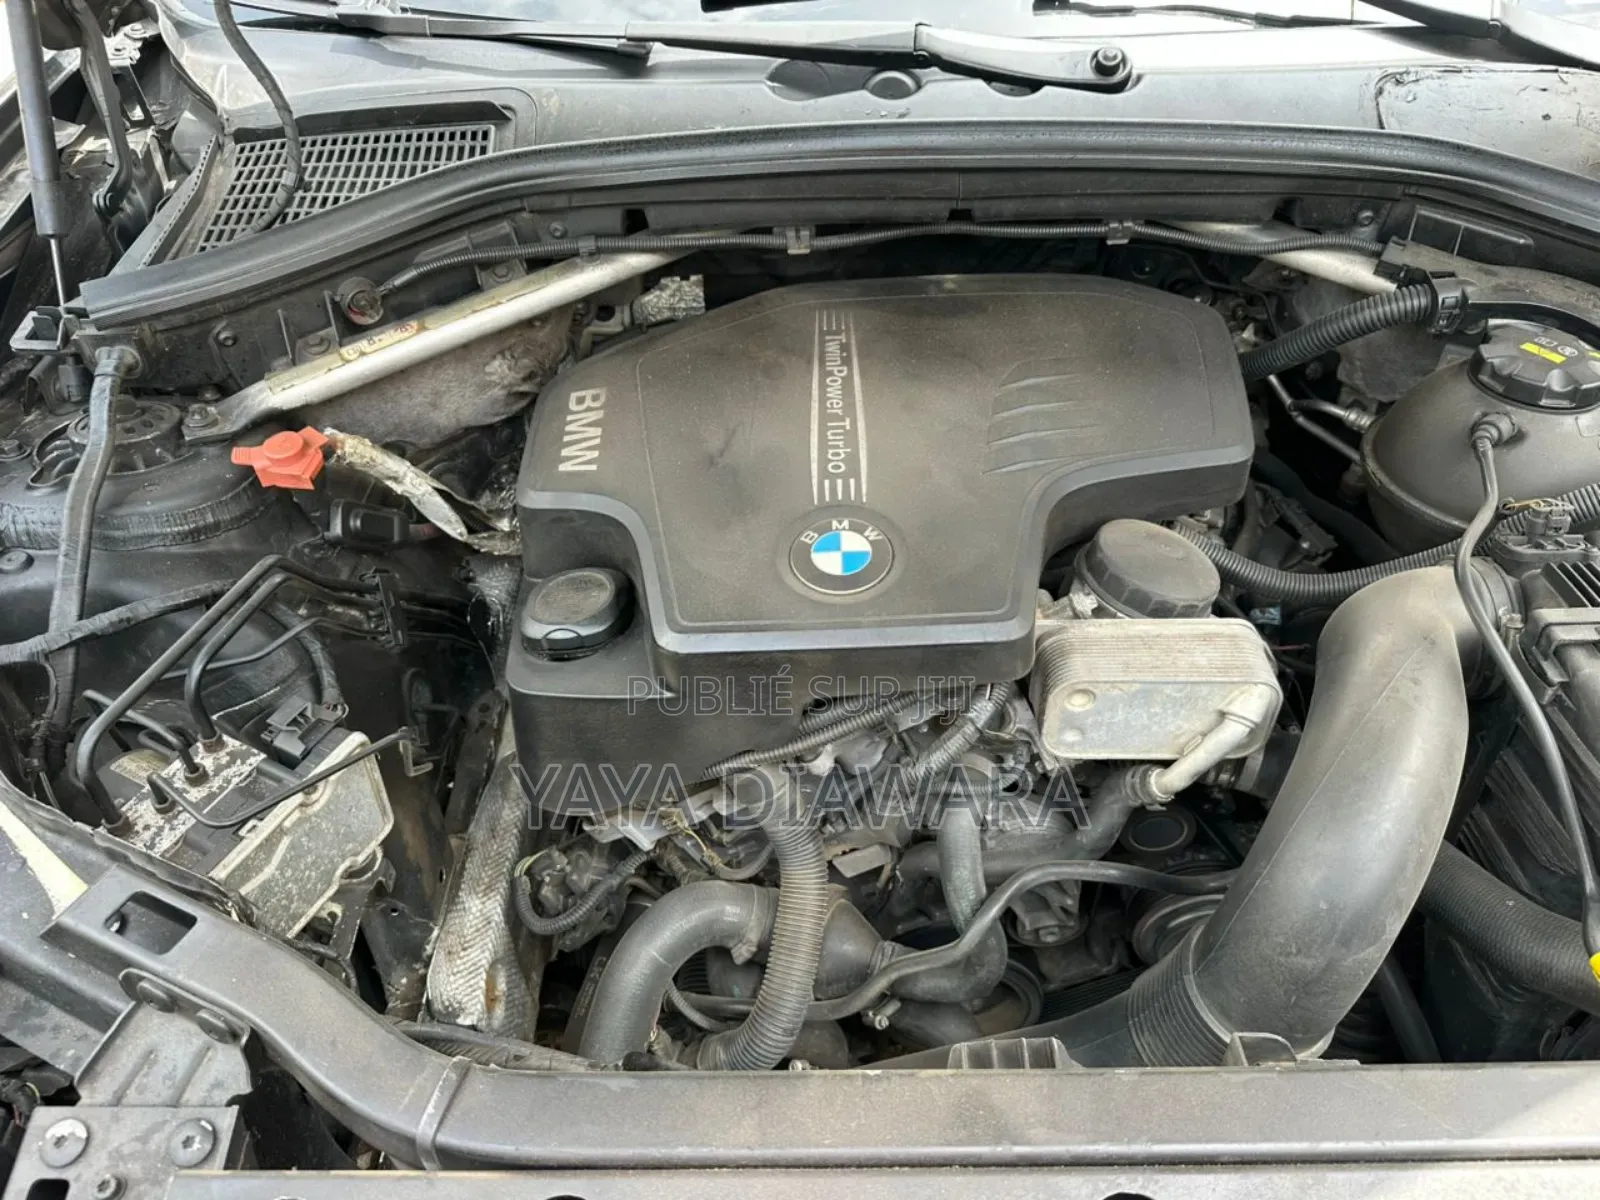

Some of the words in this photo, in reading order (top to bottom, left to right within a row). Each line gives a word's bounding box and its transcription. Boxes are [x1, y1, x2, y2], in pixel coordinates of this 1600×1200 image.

[824, 333, 848, 416] TwinPower
[558, 387, 607, 472] BMW
[826, 416, 852, 474] Turbo
[800, 519, 883, 546] BMW
